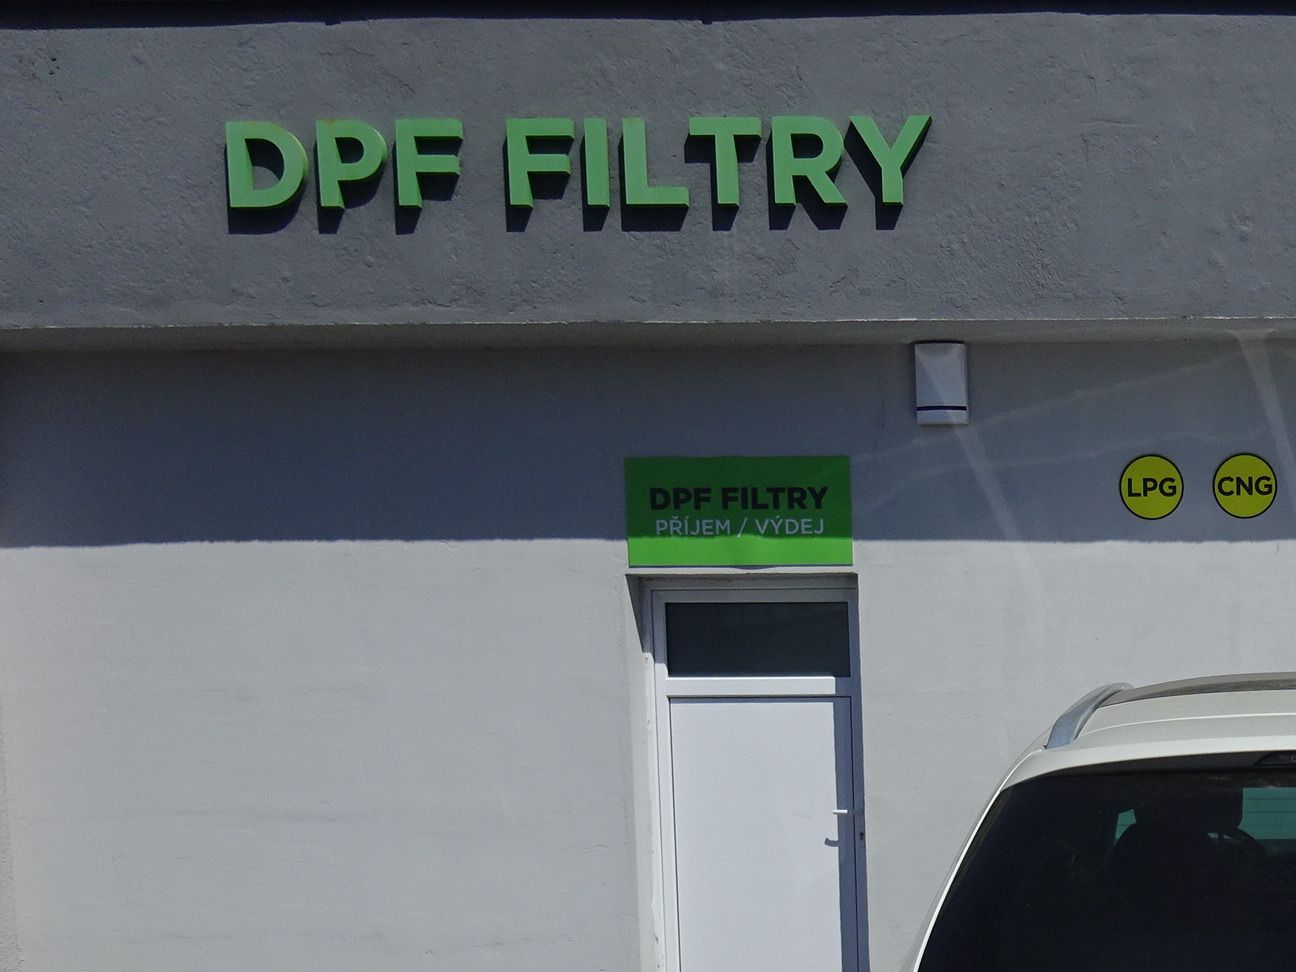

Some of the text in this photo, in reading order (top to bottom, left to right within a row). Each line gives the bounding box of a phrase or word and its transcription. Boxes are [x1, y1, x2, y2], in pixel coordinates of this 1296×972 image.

[225, 115, 933, 208] DPF FILTRY
[1127, 477, 1177, 498] LPG
[1217, 476, 1273, 496] CNG
[650, 486, 829, 511] DPF FILTRY
[655, 515, 731, 535] PŘÍJEM
[755, 515, 825, 535] VÝDEJ
